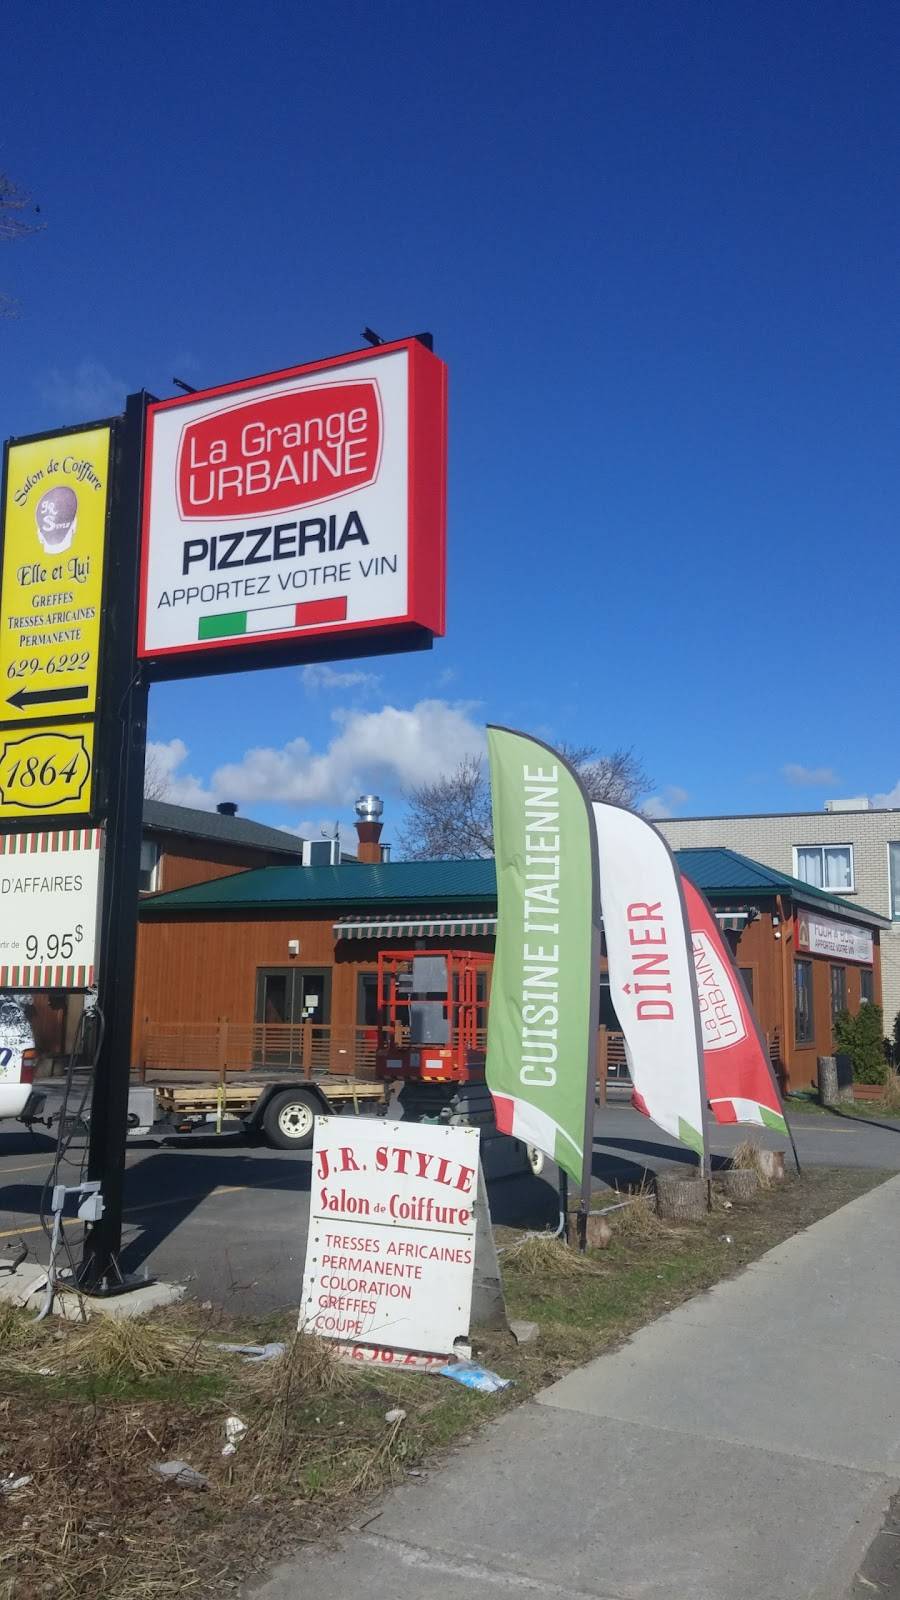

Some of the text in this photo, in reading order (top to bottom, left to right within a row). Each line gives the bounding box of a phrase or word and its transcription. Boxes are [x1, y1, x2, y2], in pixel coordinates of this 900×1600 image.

[190, 407, 368, 469] La Grange
[14, 456, 102, 507] Salon de Coiffure
[189, 437, 368, 506] URBAINE
[182, 510, 370, 576] PIZZERIA
[17, 556, 90, 586] Elle et Lui
[157, 554, 398, 609] APPORTEZ VOTRE VIN
[32, 592, 73, 608] GREFFES
[8, 607, 96, 629] TRESSES AFRICAINES
[19, 628, 81, 647] PERMANENTE
[7, 652, 90, 679] 629-6222
[7, 753, 80, 788] 1864
[1, 875, 83, 893] D'AFFAIRES
[519, 765, 560, 1088] CUISINE ITALIENNE
[11, 940, 20, 948] de
[622, 902, 674, 1021] DÎNER
[315, 1146, 476, 1194] J.R. STYLE
[320, 1187, 470, 1226] Salon de Coiffure
[325, 1234, 472, 1265] TRESSES AFRICAINES
[321, 1255, 422, 1280] PERMANENTE
[320, 1274, 412, 1299] COLORATION
[318, 1294, 377, 1315] GREFFES
[315, 1315, 364, 1336] COUPE
